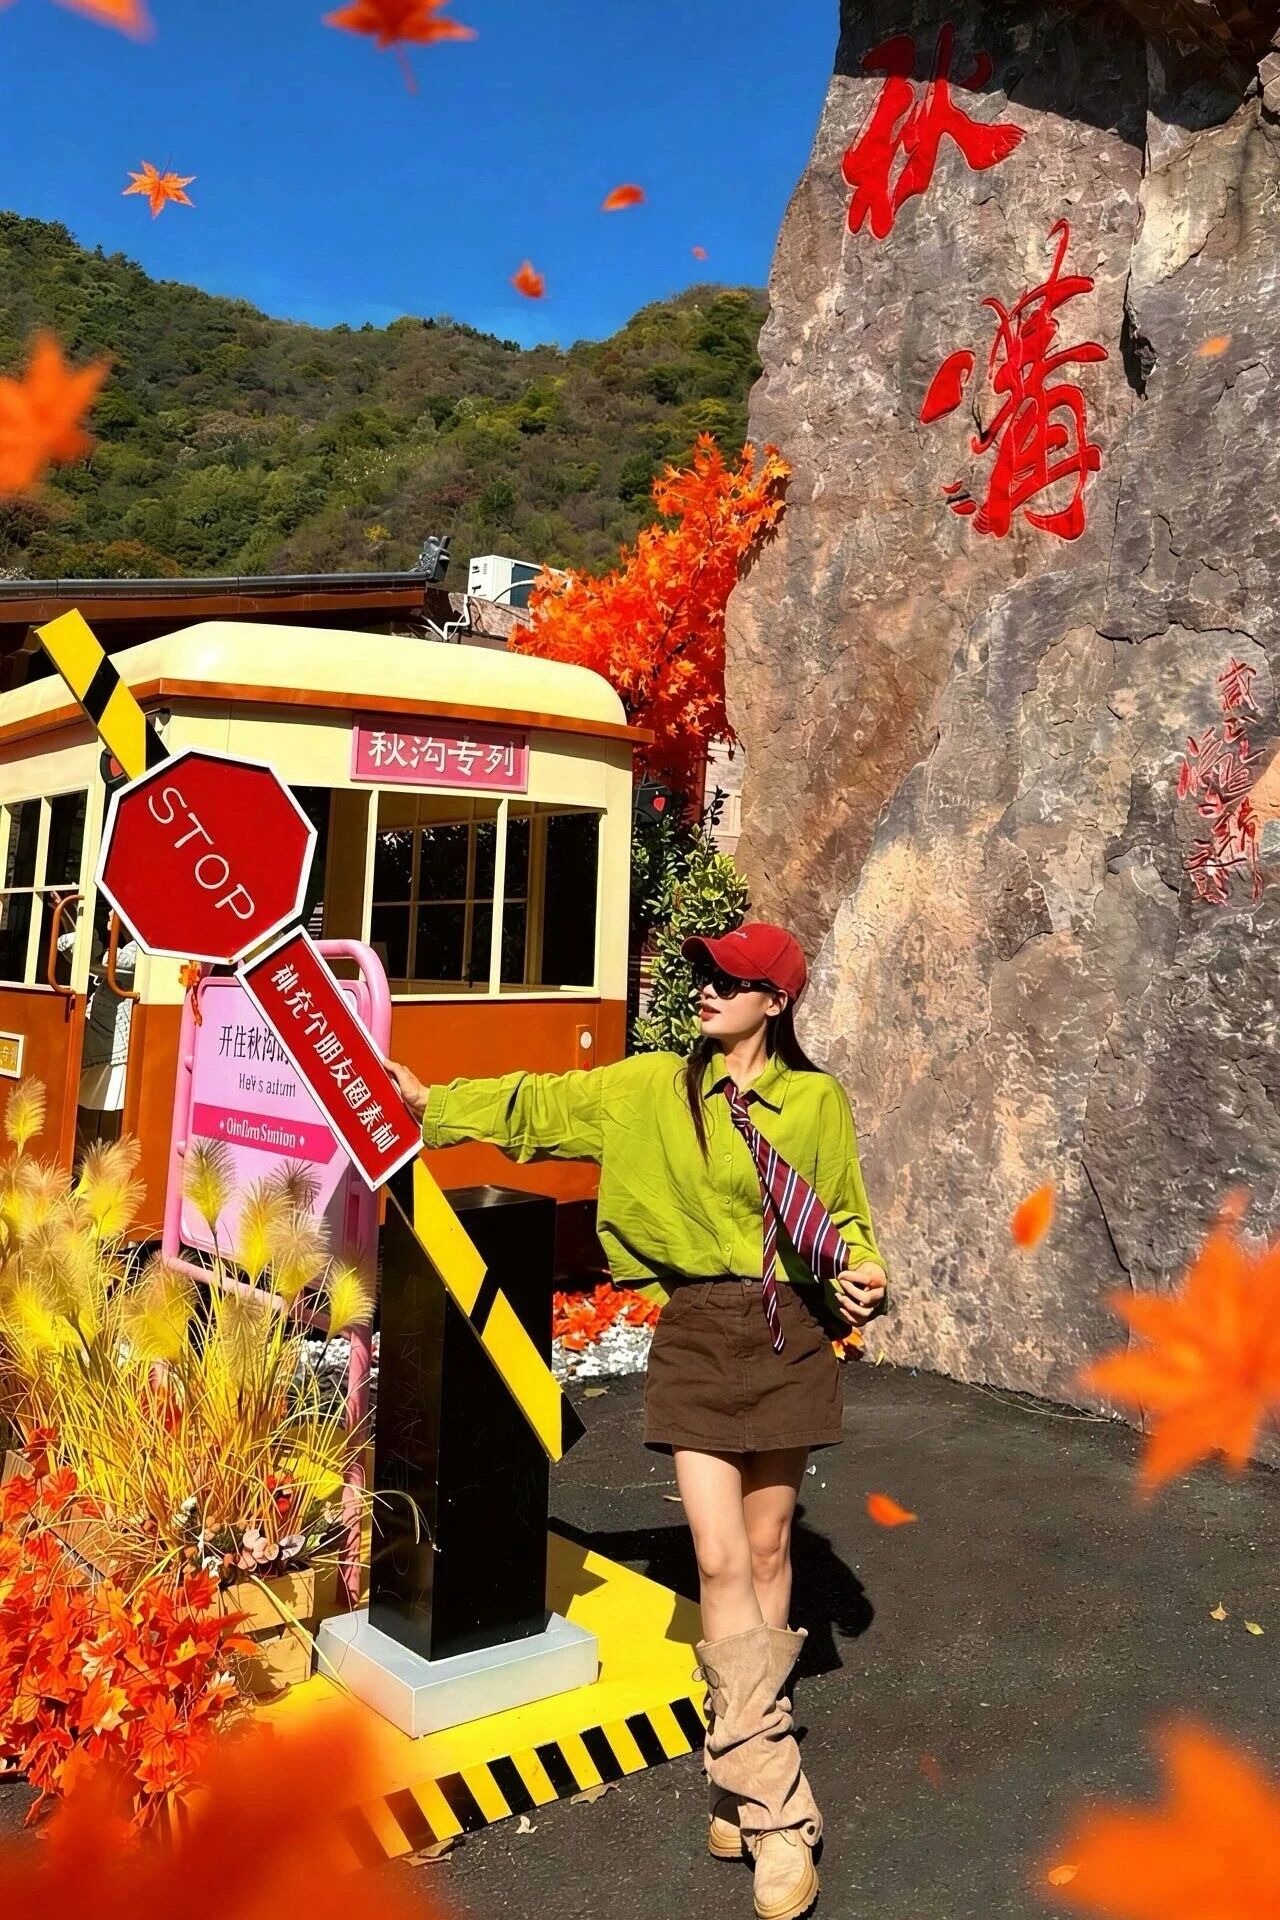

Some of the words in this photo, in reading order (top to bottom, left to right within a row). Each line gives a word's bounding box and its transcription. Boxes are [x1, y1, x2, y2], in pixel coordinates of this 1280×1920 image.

[368, 731, 514, 777] 秋沟专列
[148, 787, 256, 920] STOP
